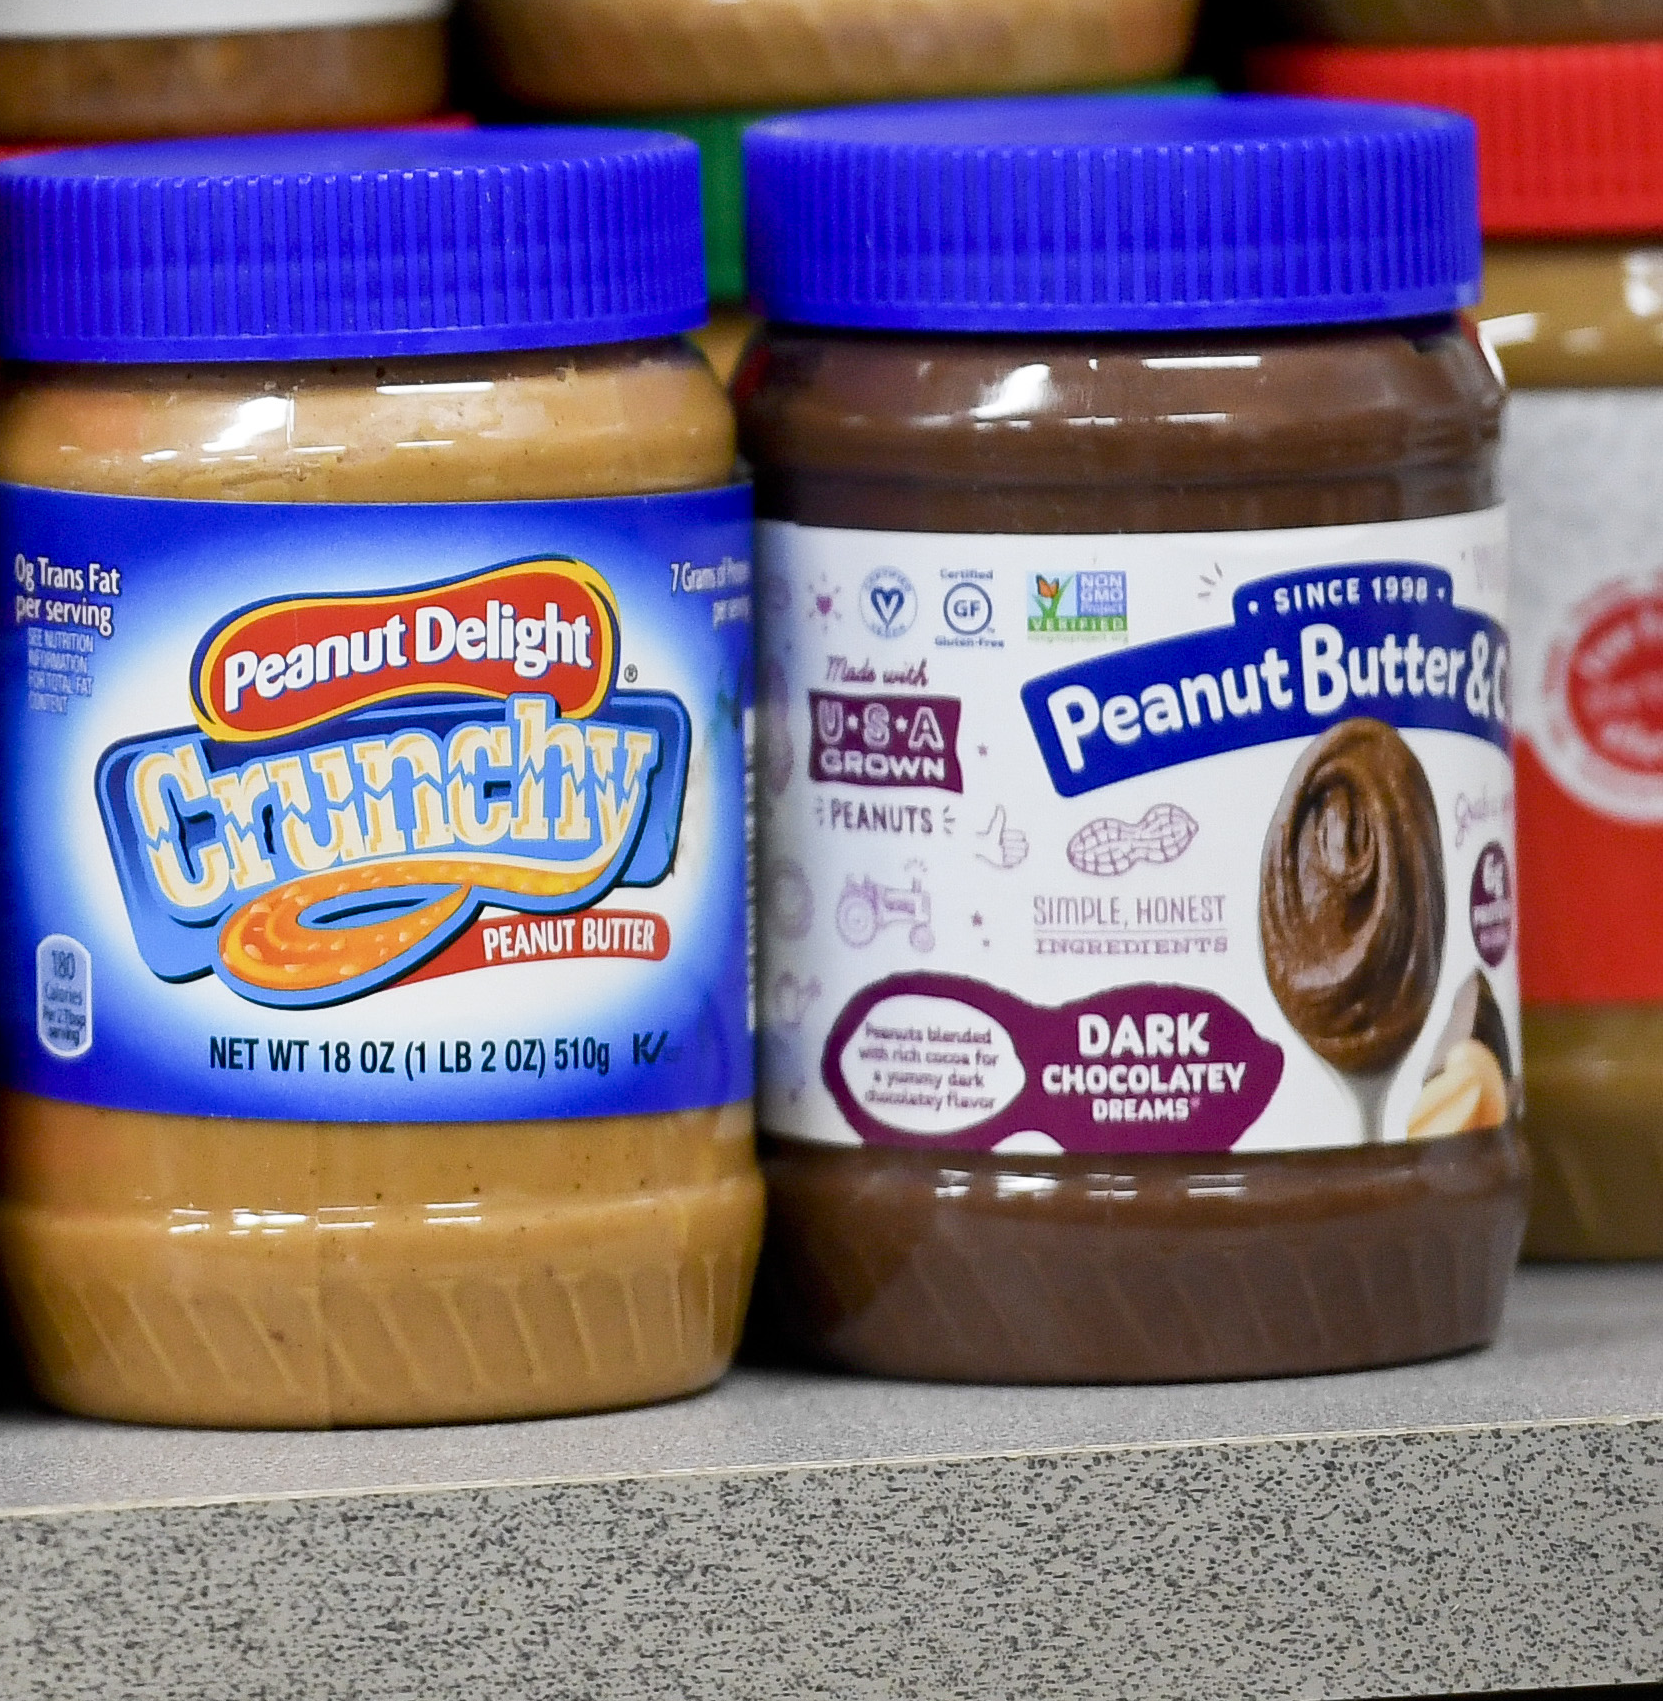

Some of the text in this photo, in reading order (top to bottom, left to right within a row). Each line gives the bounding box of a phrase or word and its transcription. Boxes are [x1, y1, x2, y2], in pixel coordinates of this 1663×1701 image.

[14, 553, 121, 595] 0g Trans Fat
[939, 568, 994, 581] Certified
[1080, 573, 1124, 588] NON
[953, 600, 981, 618] GF
[1081, 588, 1125, 602] GMO
[1273, 575, 1430, 615] SINCE 1998
[16, 594, 113, 637] per serving
[1030, 616, 1125, 631] VERIFIED
[224, 599, 593, 714] Peanut Delight
[881, 657, 930, 688] with
[1045, 649, 1294, 773] Peanut
[1301, 622, 1465, 714] Butter
[820, 748, 945, 782] GROWN
[131, 696, 657, 912] Crunchy
[830, 799, 934, 835] PEANUTS
[1033, 894, 1227, 931] SIMPLE, HONEST
[483, 916, 655, 961] PEANUT BUTTER
[1034, 933, 1229, 956] INGREDIENTS
[865, 1022, 991, 1044] Peanuts blended
[1078, 1014, 1211, 1059] DARK
[208, 1035, 611, 1079] NET WT 18 OZ (1 LB 2 OZ) 510g
[925, 1051, 970, 1065] cocoa
[948, 1067, 984, 1087] dark
[1041, 1061, 1247, 1095] CHOCOLATEY
[1091, 1096, 1191, 1123] DREAMS
